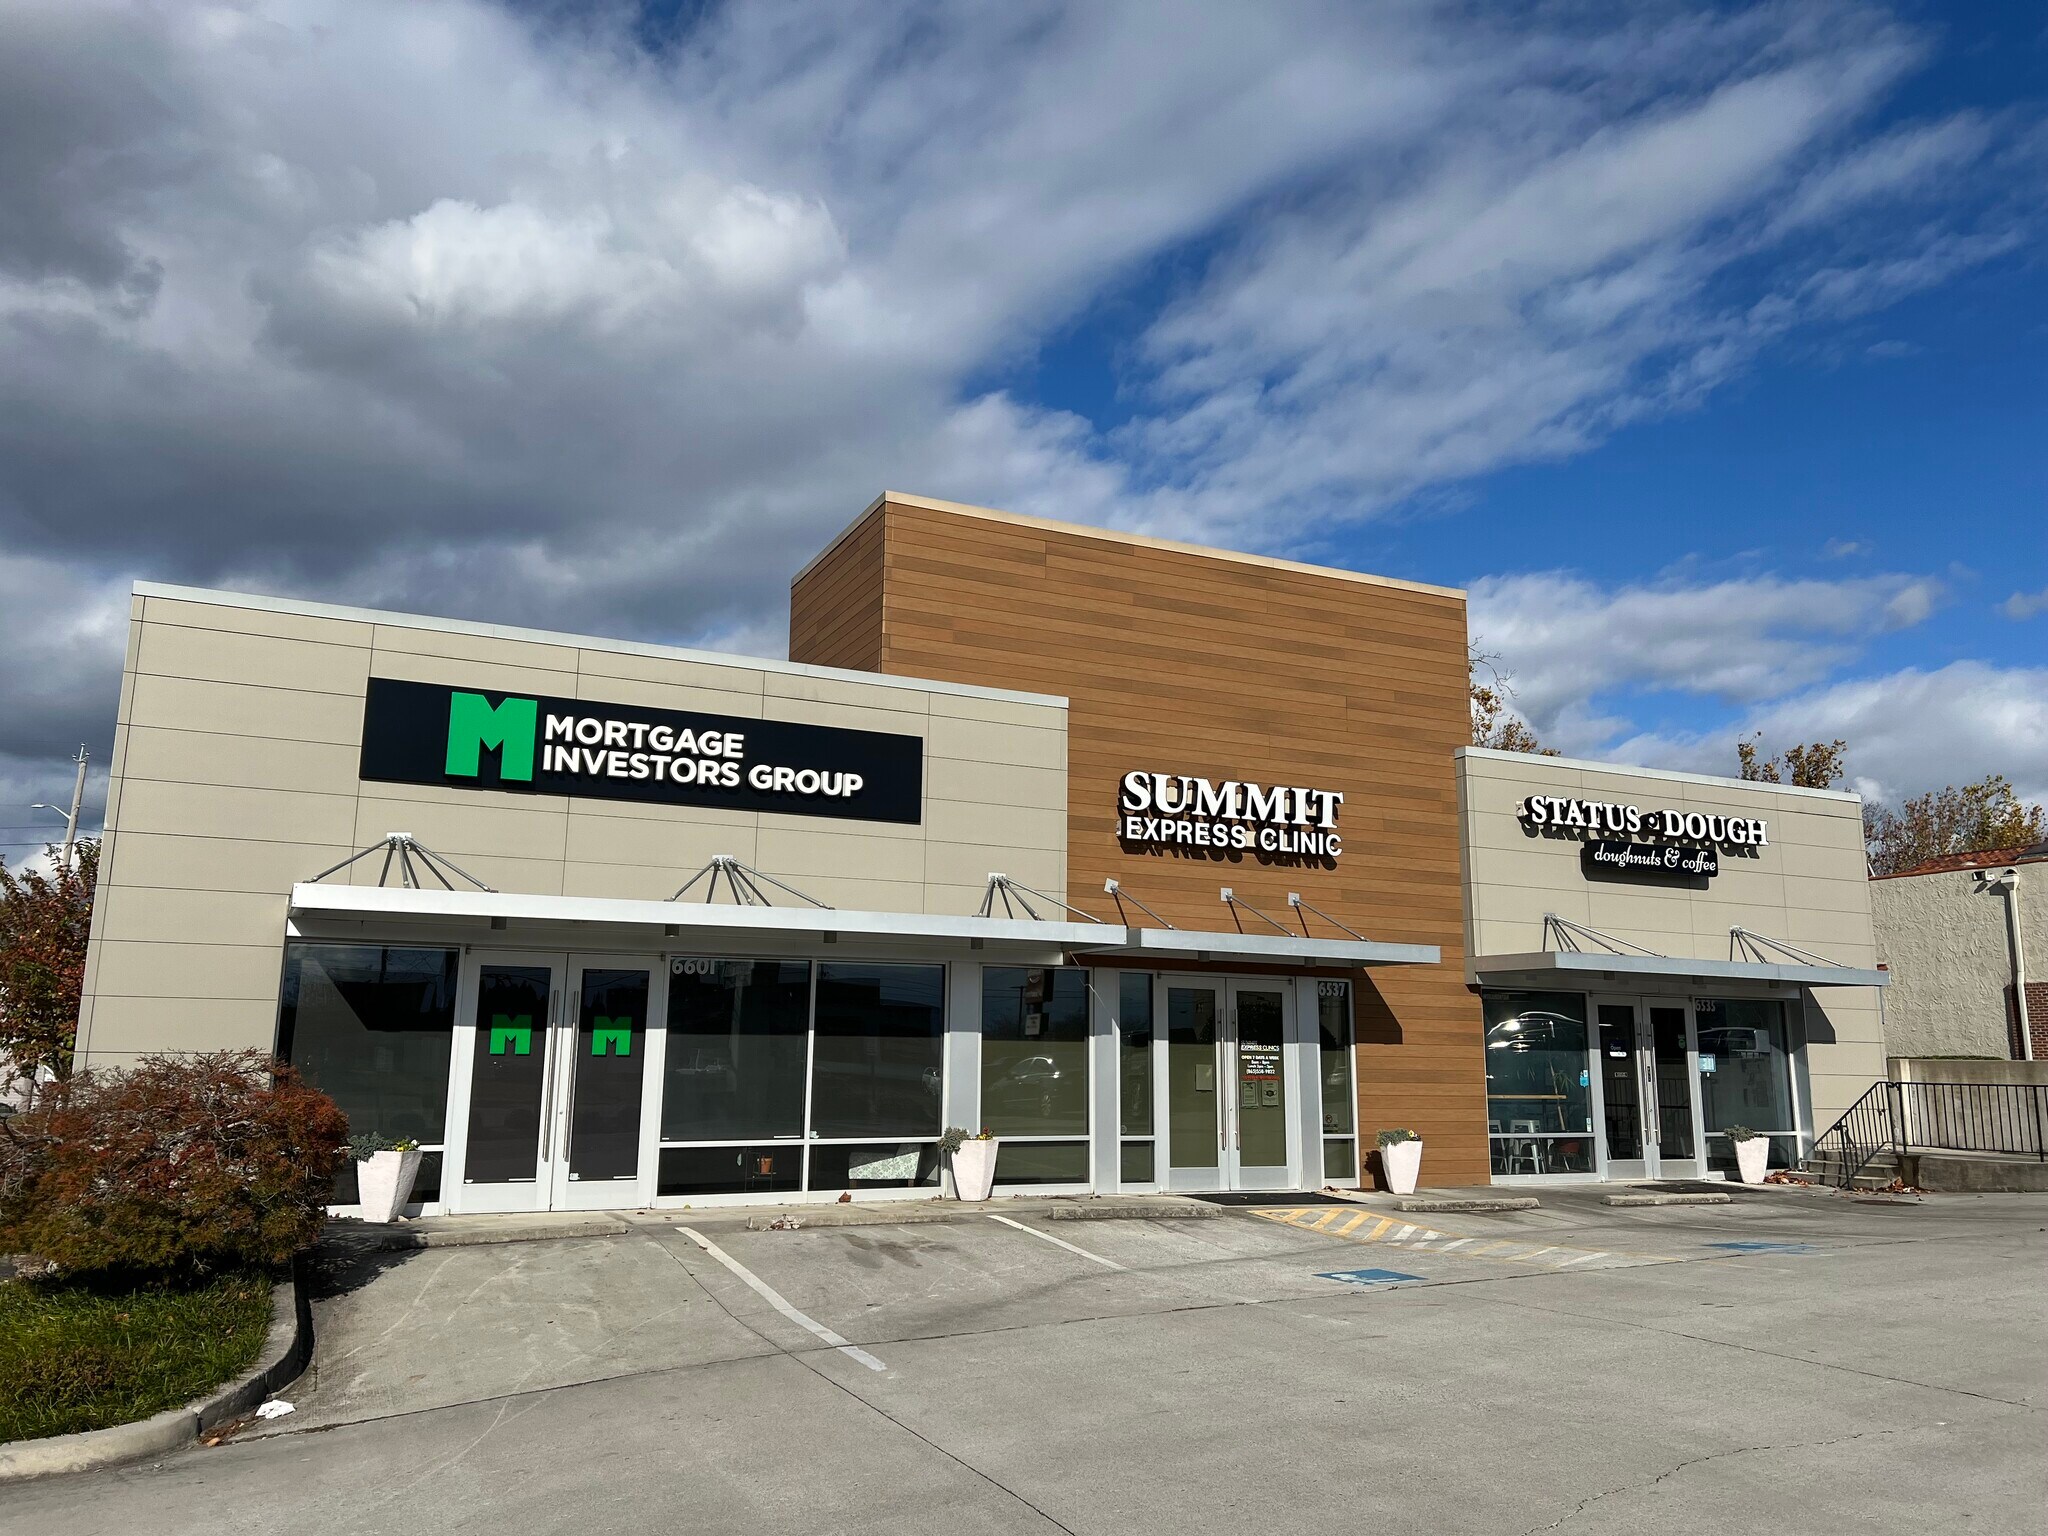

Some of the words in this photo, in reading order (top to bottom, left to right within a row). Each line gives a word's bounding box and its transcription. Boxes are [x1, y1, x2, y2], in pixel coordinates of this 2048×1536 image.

[445, 691, 537, 781] M
[544, 713, 744, 759] MORTGAGE
[542, 745, 741, 787] INVESTORS
[748, 764, 863, 797] GROUP
[1122, 771, 1344, 829] SUMMIT
[1530, 795, 1641, 833] STATUS
[1663, 809, 1770, 846] DOUGH
[1126, 816, 1247, 848] EXPRESS
[1260, 828, 1343, 857] CLINIC
[1594, 843, 1661, 868] doughnuts
[1664, 847, 1680, 868] &
[1682, 851, 1716, 873] coffee
[671, 958, 715, 975] 6601
[1318, 982, 1346, 997] 6537
[1695, 999, 1716, 1012] 6535
[489, 1014, 532, 1056] M
[591, 1016, 632, 1057] M
